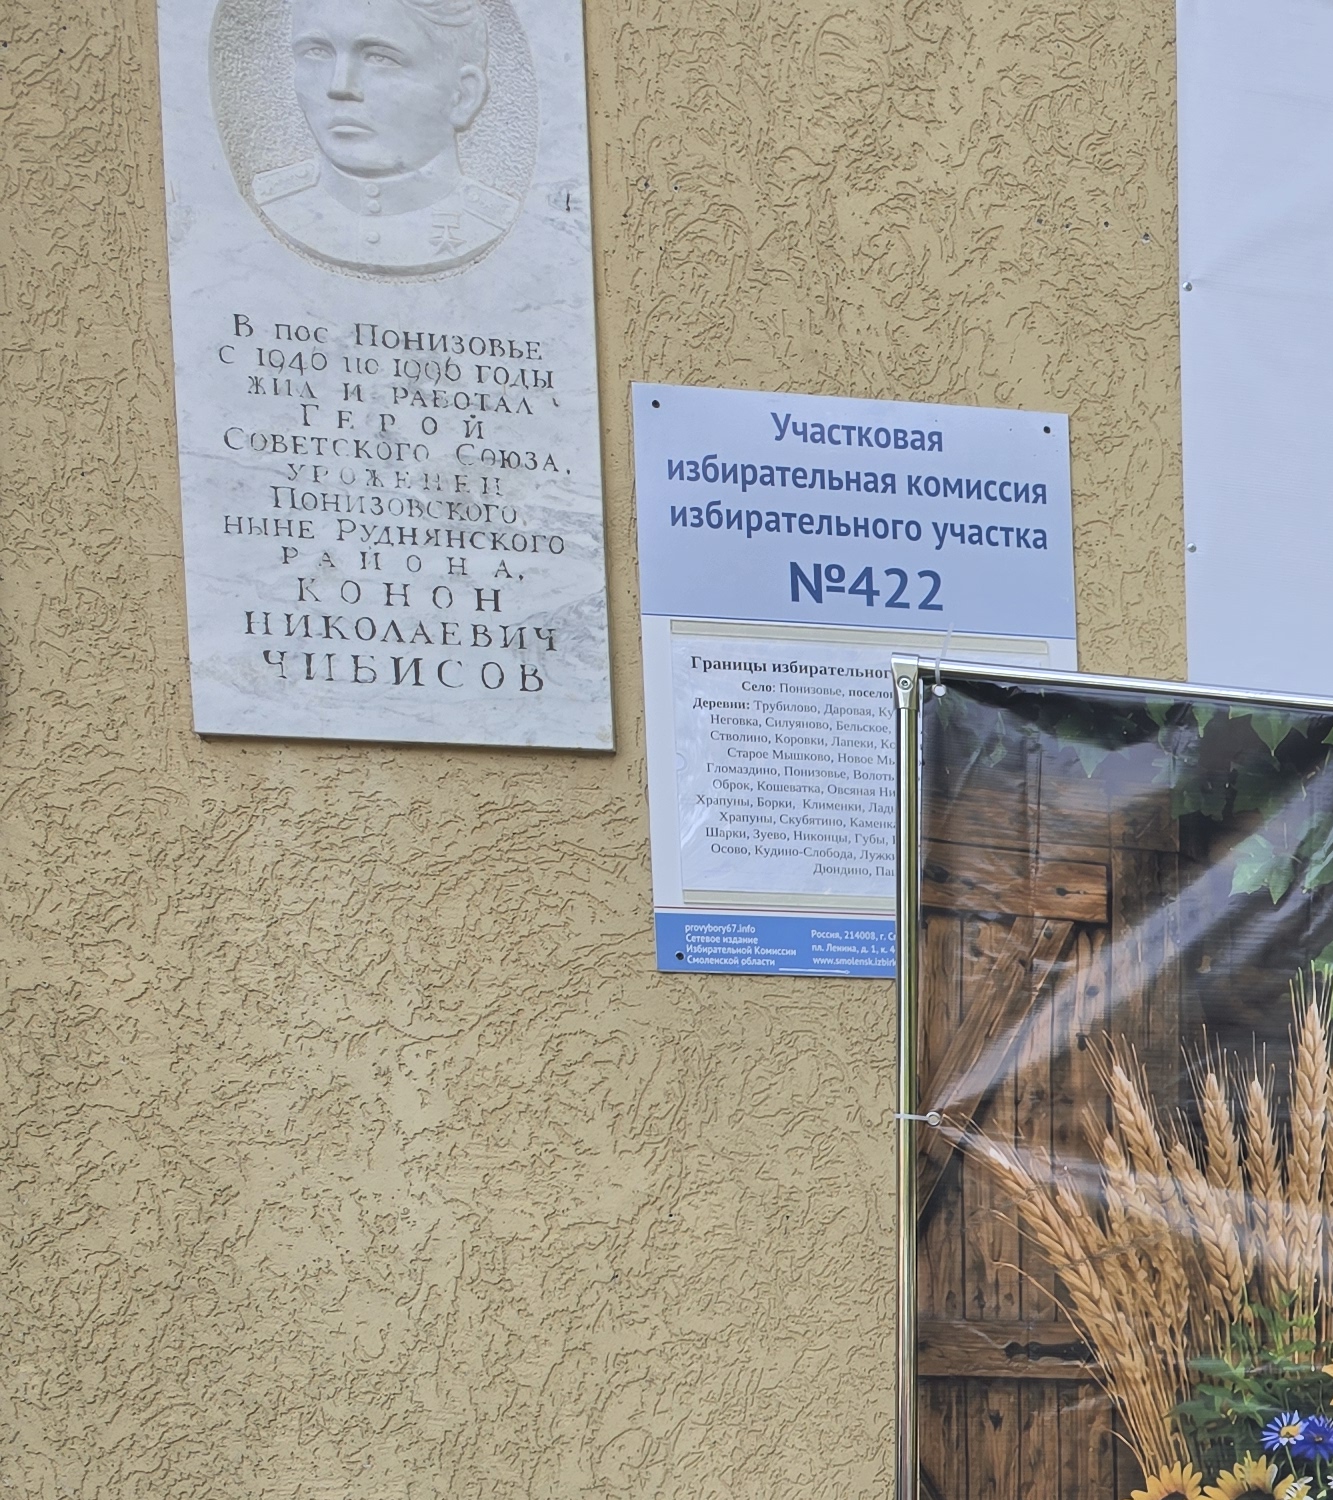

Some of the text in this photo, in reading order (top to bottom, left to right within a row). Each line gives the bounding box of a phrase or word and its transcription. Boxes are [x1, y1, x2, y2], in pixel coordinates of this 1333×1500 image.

[233, 313, 254, 337] В
[218, 345, 235, 364] С
[393, 357, 462, 386] 1996
[247, 375, 533, 415] ЖИЛ И РАБОТАЛ
[300, 403, 484, 439] ГЕРОЙ
[770, 412, 944, 452] Участковая
[666, 454, 1048, 505] избирательная комиссия
[223, 515, 315, 539] НЫНЕ
[669, 500, 1048, 551] избирательного участка
[297, 577, 502, 612] КОНОН
[789, 561, 944, 612] №422
[243, 610, 558, 652] НИКОЛАЕВИЧ
[262, 650, 544, 693] ЧИБИСОВ
[690, 656, 767, 674] Границы
[741, 681, 776, 693] Село:
[780, 682, 845, 697] Понизовье,
[692, 697, 750, 711] Деревни:
[753, 700, 820, 714] Трубилово,
[824, 703, 875, 717] Даровая,
[711, 714, 892, 734] Неговка, Силуяново, Бельское,
[711, 730, 771, 744] Стволино,
[775, 733, 828, 747] Коровки,
[727, 747, 769, 761] Старое
[772, 750, 834, 764] Мышково,
[837, 752, 874, 765] Новое
[707, 762, 781, 777] Гломаздино,
[784, 766, 850, 781] Понизовье,
[712, 779, 753, 792] Оброк,
[757, 781, 824, 795] Кошеватка,
[827, 784, 876, 796] Овсяная
[696, 794, 753, 808] Храпуны,
[757, 797, 796, 810] Борки,
[720, 812, 776, 825] Храпуны,
[780, 814, 846, 828] Скубятино,
[706, 827, 750, 840] Шарки,
[753, 829, 790, 842] Зуево,
[793, 830, 851, 844] Никонцы,
[855, 833, 889, 846] Губы,
[711, 843, 751, 856] Осово,
[685, 934, 759, 945] Сетевое издание
[686, 944, 797, 956] Избирательной Комиссии
[687, 955, 776, 966] Смоленской области
